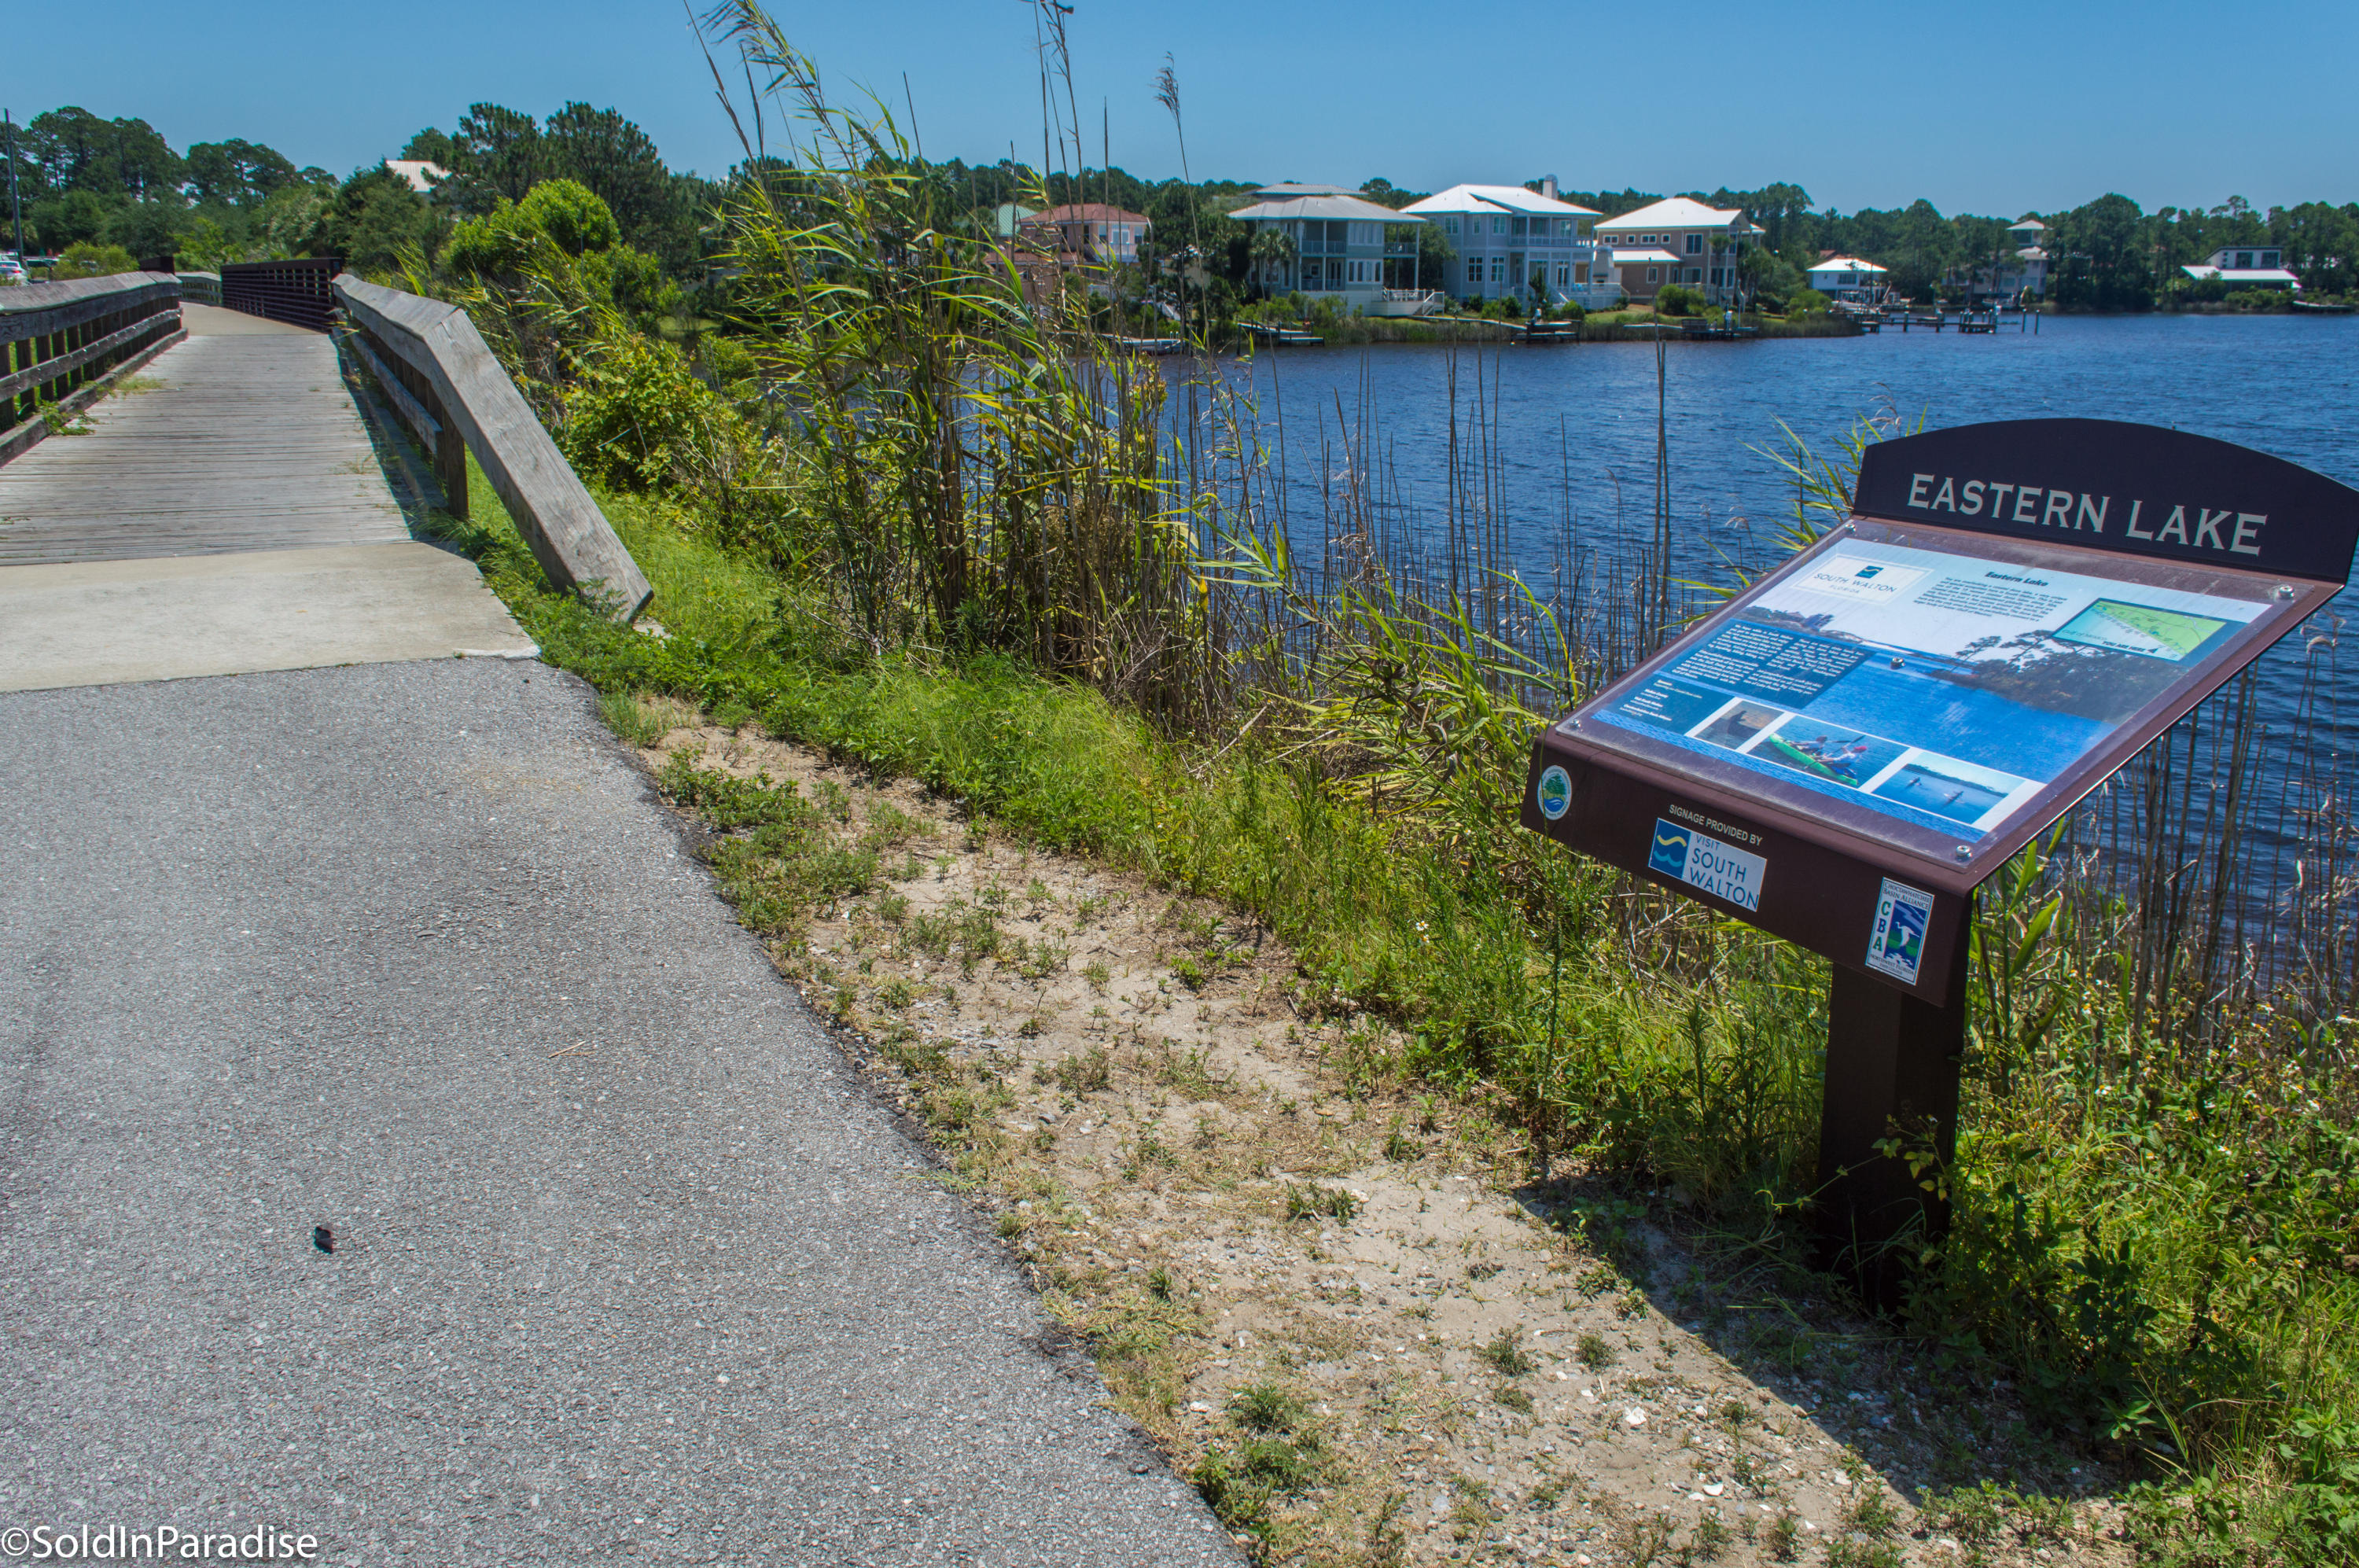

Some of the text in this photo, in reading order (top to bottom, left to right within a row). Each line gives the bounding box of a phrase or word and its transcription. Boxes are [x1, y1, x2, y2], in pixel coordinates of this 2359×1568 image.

[1908, 473, 2268, 557] EASTERN LAKE
[1814, 573, 1897, 592] SOUTH WALTON
[1985, 572, 2048, 587] Eastern Lake
[1669, 804, 1763, 846] SIGNAGE PROVIDED BY
[1696, 834, 1720, 851] VISIT
[1691, 848, 1747, 883] SOUTH
[1689, 867, 1759, 909] WALTON
[1882, 888, 1929, 909] BASIN ALLIANCE
